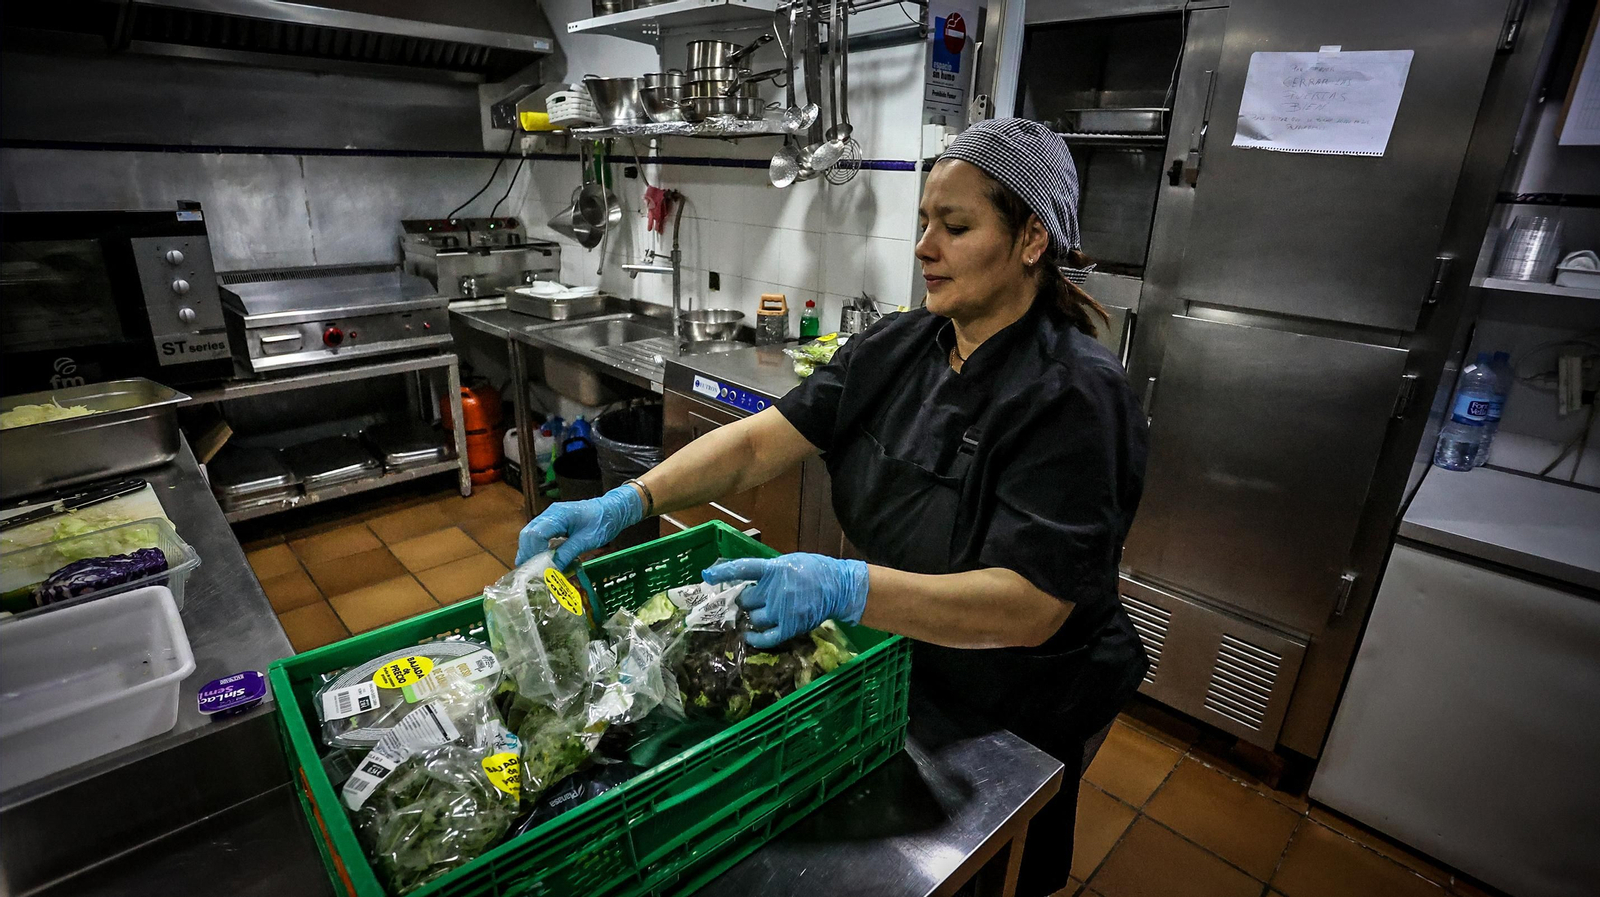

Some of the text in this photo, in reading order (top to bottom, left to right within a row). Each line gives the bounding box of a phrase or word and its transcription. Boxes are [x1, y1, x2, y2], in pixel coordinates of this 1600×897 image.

[162, 341, 226, 356] ST series
[50, 374, 85, 390] fm
[390, 664, 407, 684] PRECIO
[406, 656, 426, 680] BAJADA
